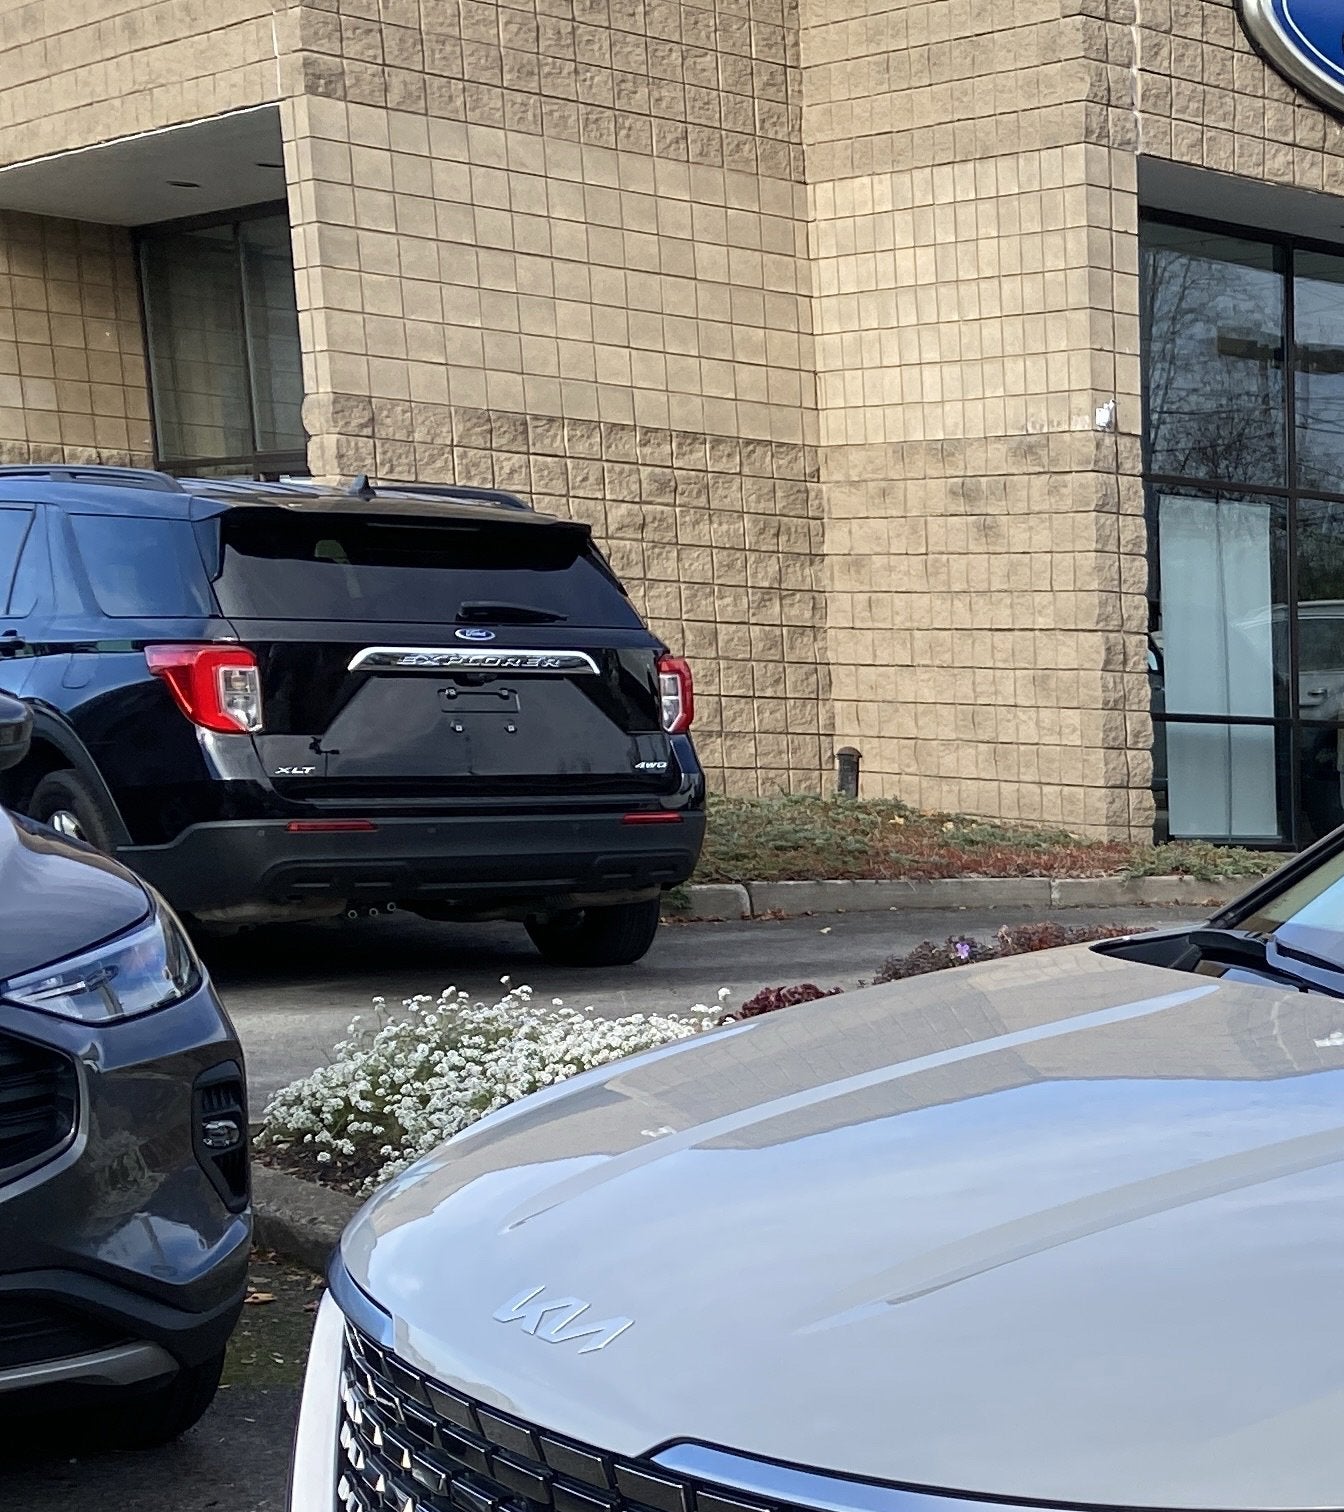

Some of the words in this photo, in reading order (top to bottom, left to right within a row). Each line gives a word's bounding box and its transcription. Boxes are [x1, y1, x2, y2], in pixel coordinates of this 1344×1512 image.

[396, 655, 560, 668] EXPLORER
[634, 761, 668, 769] 4WD
[274, 766, 316, 774] XLT
